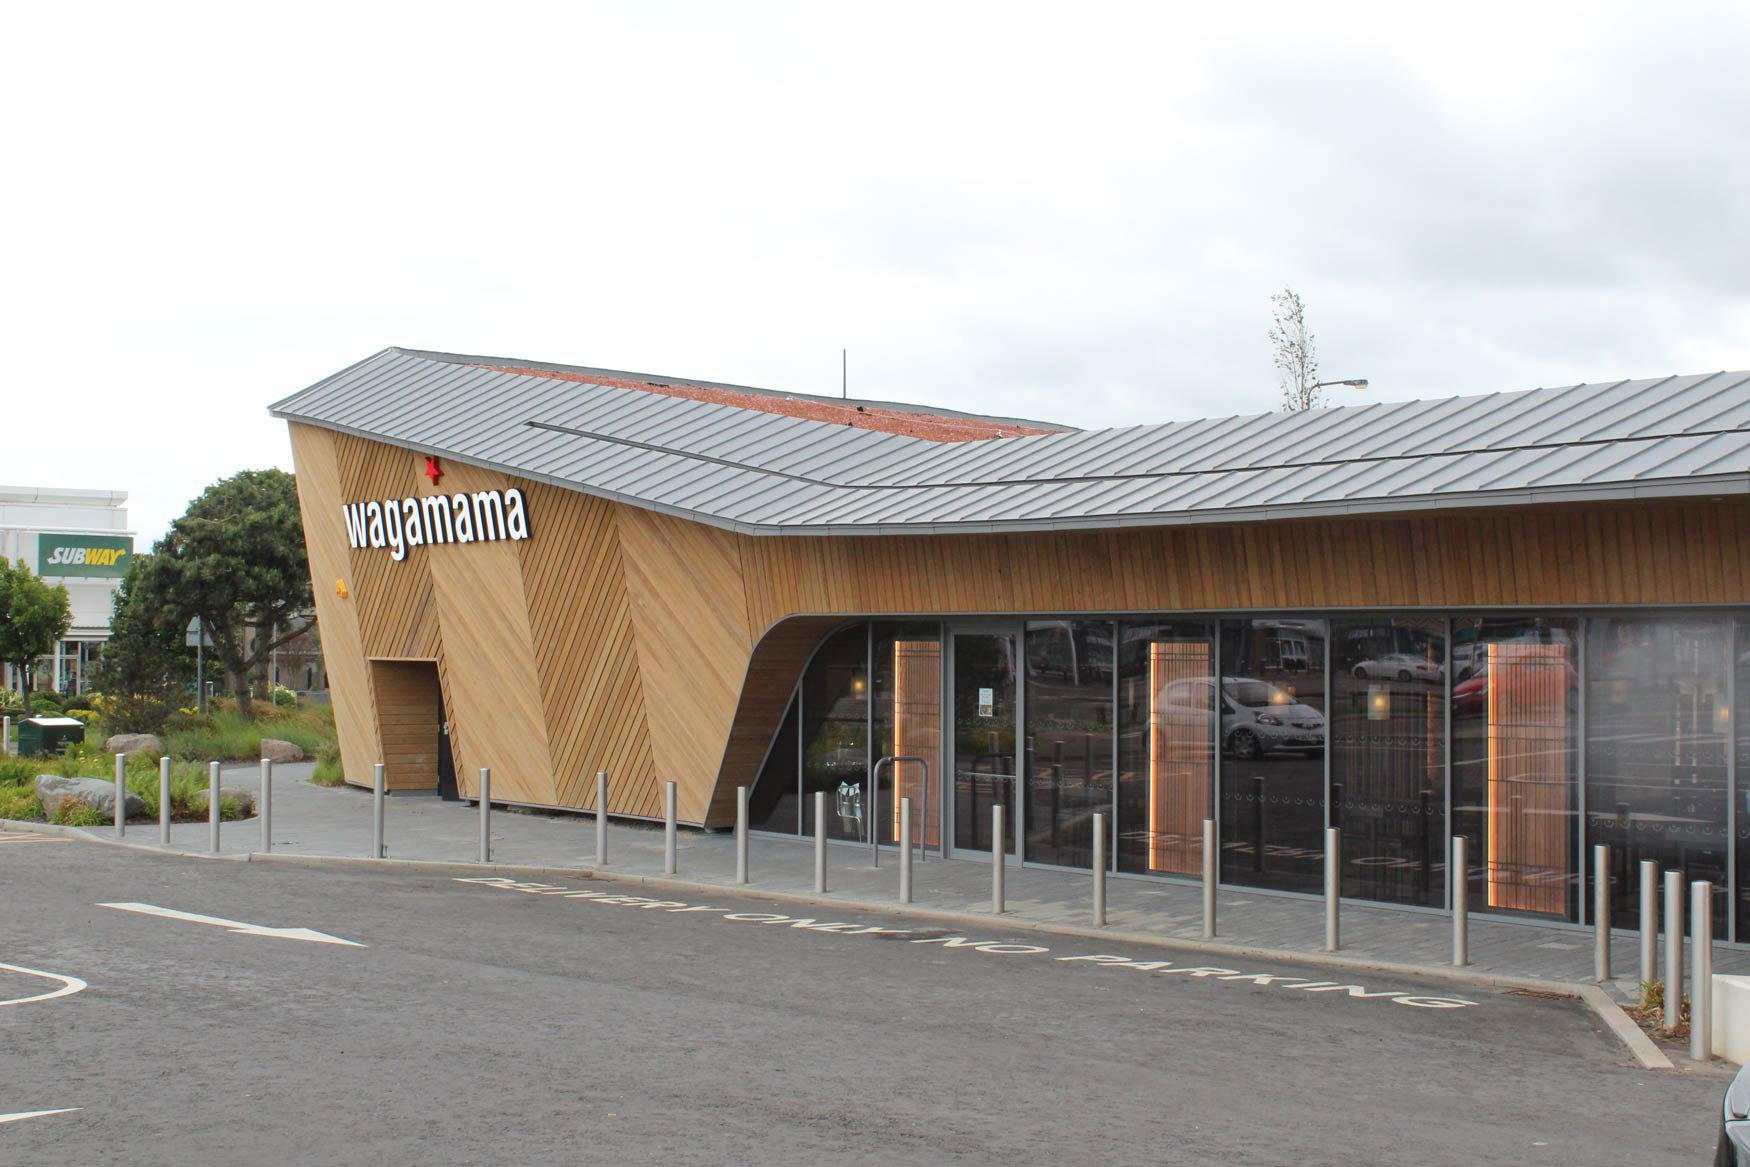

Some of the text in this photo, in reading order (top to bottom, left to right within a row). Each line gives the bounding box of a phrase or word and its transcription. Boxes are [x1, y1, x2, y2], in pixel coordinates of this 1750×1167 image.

[47, 547, 126, 566] SUBWAY
[343, 488, 529, 561] wagamama
[452, 877, 1479, 1008] DELIVERY ONLY NO PARKING
